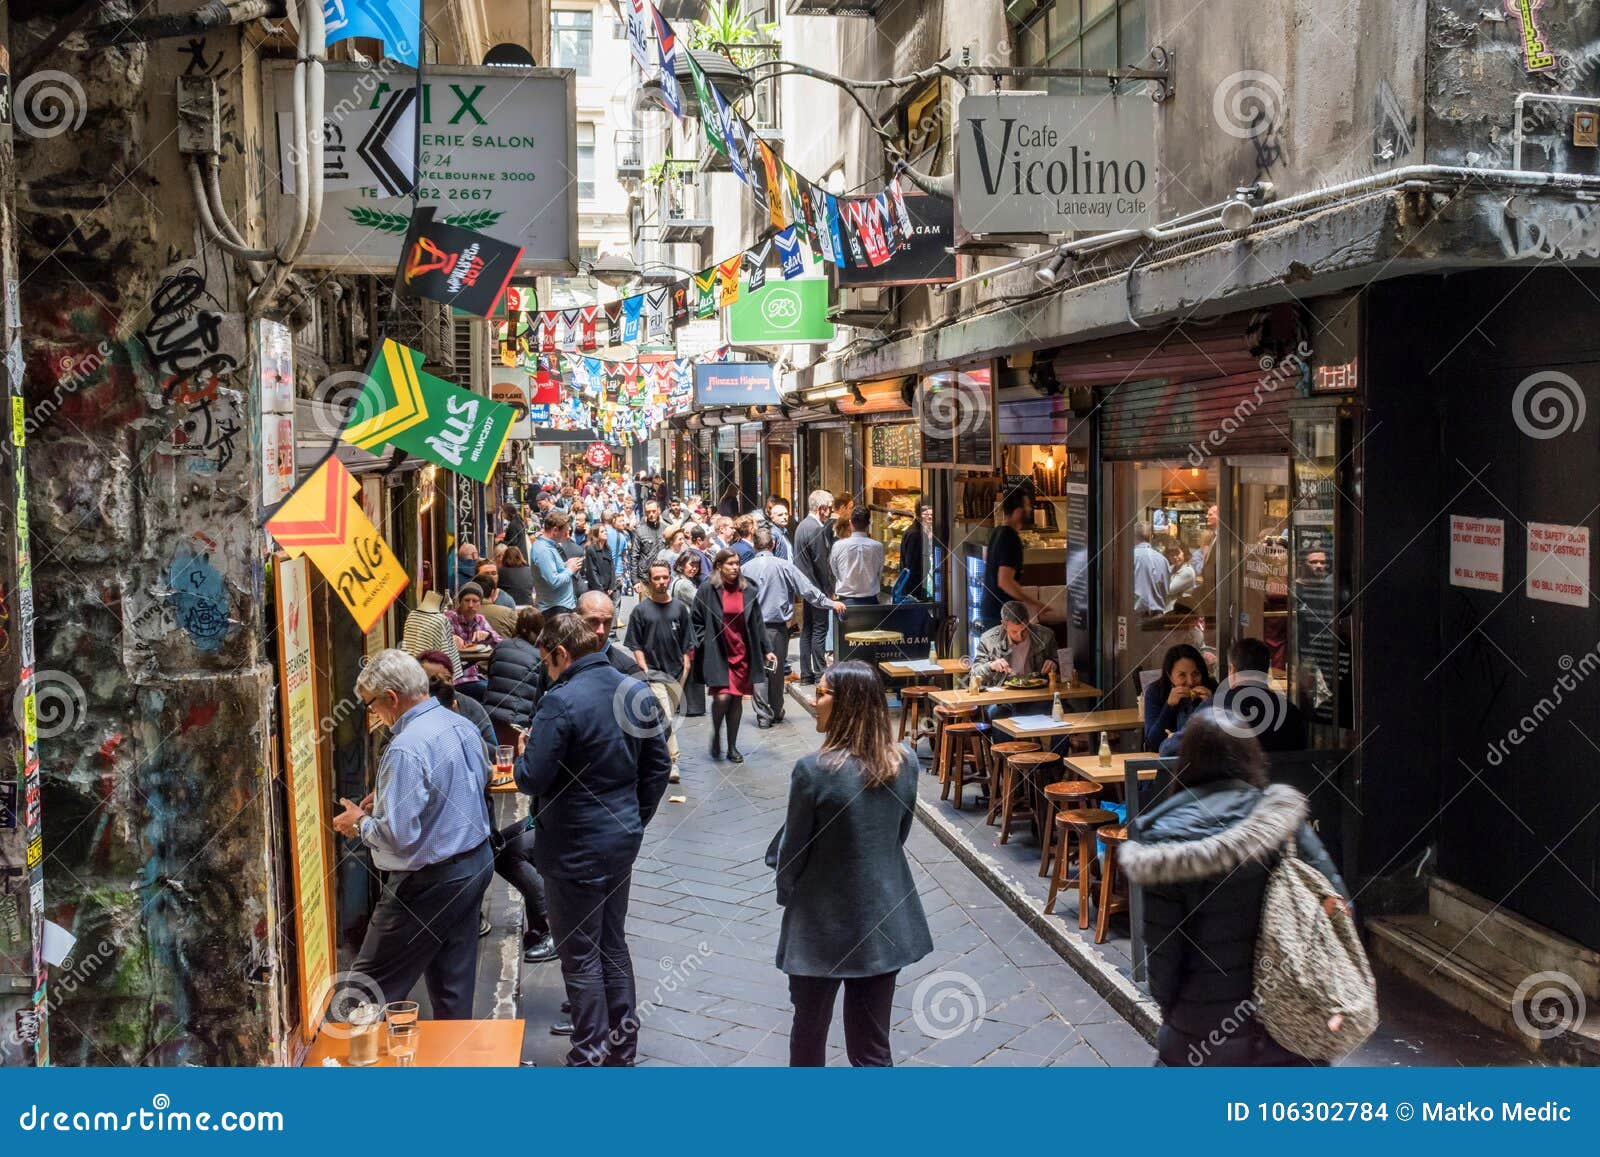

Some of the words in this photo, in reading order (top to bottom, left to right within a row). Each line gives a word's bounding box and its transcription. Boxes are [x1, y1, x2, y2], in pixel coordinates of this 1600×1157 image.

[472, 136, 535, 149] SALON
[1017, 124, 1058, 148] Cafe
[967, 118, 1146, 196] Vicolino
[419, 170, 496, 181] MELBOURNE
[500, 171, 536, 182] 3000
[449, 187, 493, 200] 2667
[1056, 201, 1113, 217] Laneway
[1116, 199, 1147, 214] Cafe
[424, 394, 480, 466] AUS
[470, 416, 495, 463] #RLWC2017
[1465, 522, 1484, 533] SAFETY
[1473, 535, 1501, 546] OBSTRUCT
[1544, 531, 1566, 541] SAFETY
[1553, 545, 1586, 556] OBSTRUCT
[337, 535, 383, 607] PNG
[1531, 579, 1541, 589] NO
[1555, 582, 1583, 596] POSTERS
